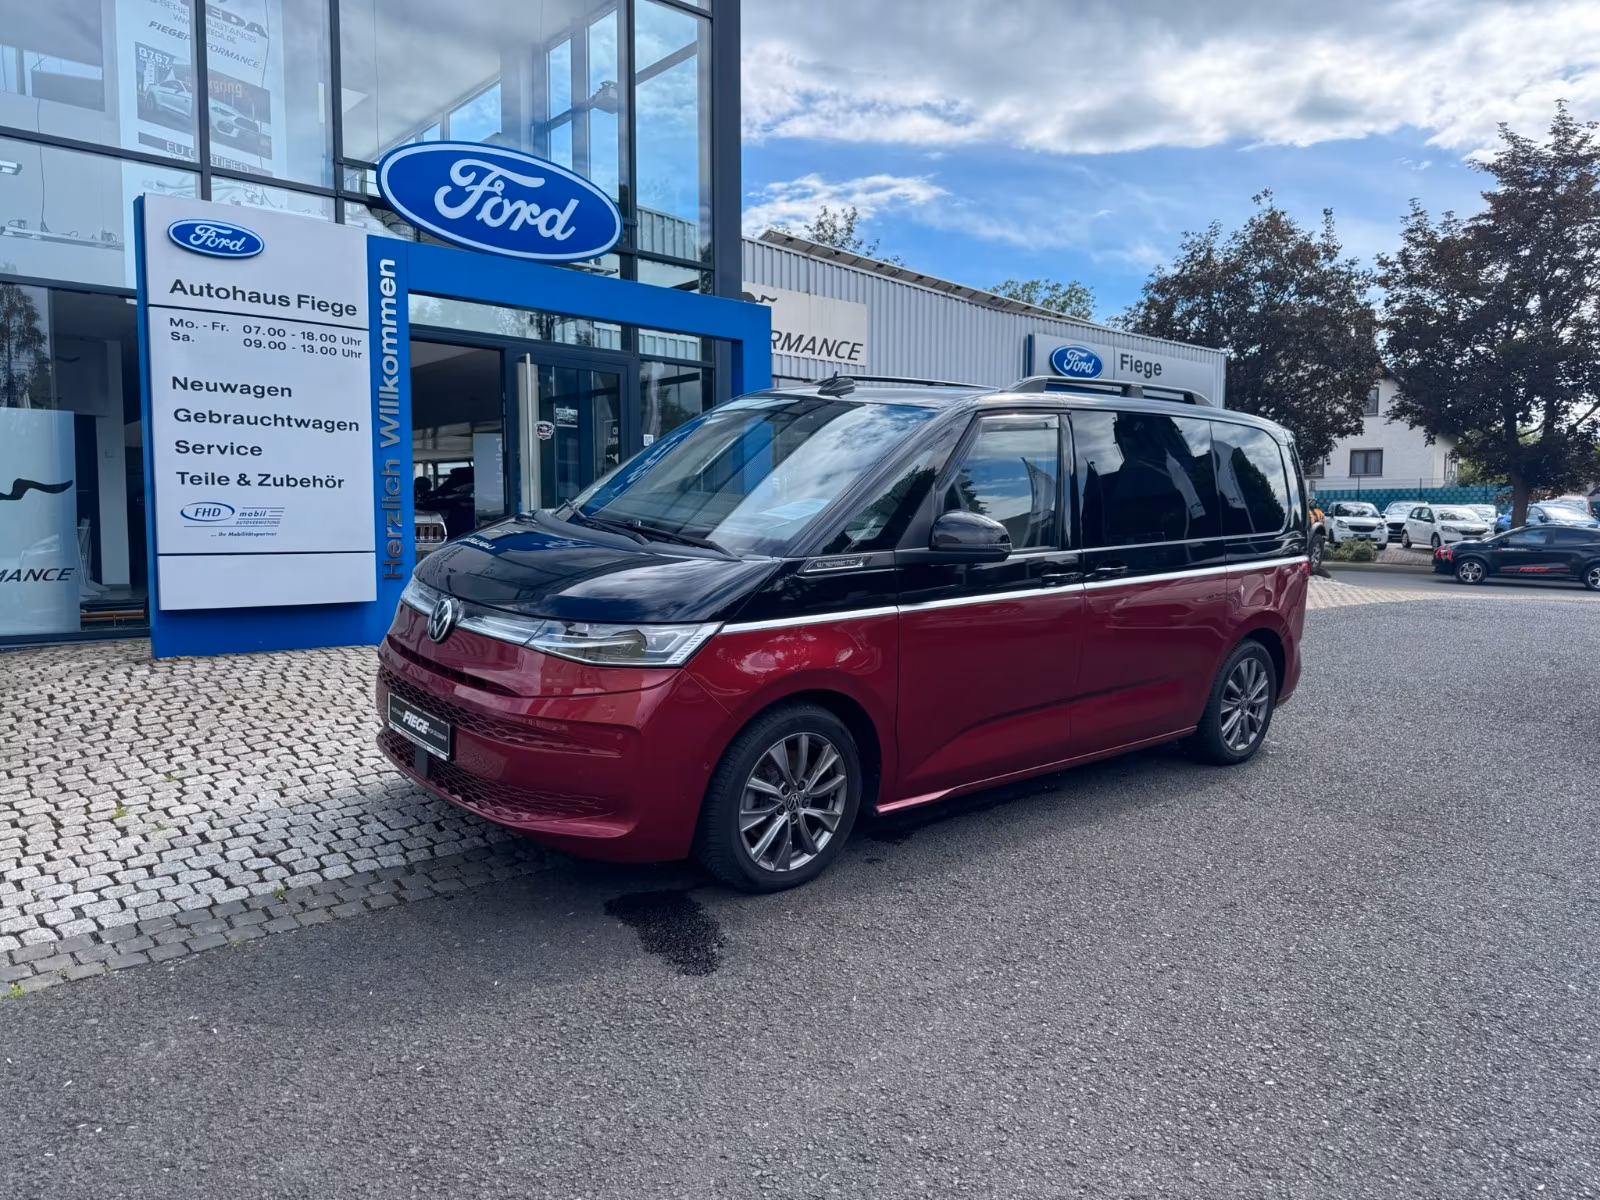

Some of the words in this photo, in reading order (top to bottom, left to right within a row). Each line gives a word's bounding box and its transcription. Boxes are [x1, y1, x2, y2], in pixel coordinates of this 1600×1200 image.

[166, 141, 184, 155] EU
[434, 158, 580, 241] Ford
[189, 224, 248, 252] Ford
[169, 279, 291, 307] Autohaus
[297, 294, 357, 317] Fiege
[169, 317, 199, 329] Mo.
[211, 321, 230, 332] Fr.
[242, 325, 286, 338] 07.00
[300, 331, 337, 344] 18.00
[341, 335, 362, 347] Uhr
[170, 331, 195, 342] Sa.
[243, 338, 287, 351] 09.00
[300, 344, 337, 356] 13.00
[342, 348, 362, 359] Uhr
[378, 258, 401, 448] Willkommen
[771, 329, 864, 361] RMANCE
[1063, 349, 1095, 374] Ford
[1120, 353, 1162, 379] Fiege
[172, 376, 293, 398] Neuwagen
[173, 408, 360, 433] Gebrauchtwagen
[174, 440, 263, 456] Service
[176, 472, 231, 487] Teile
[236, 474, 252, 487] &
[257, 473, 345, 489] Zubehör
[194, 507, 222, 517] FHD
[239, 510, 267, 518] mobil
[381, 458, 404, 580] Herzlich
[402, 710, 430, 735] FIEGE
